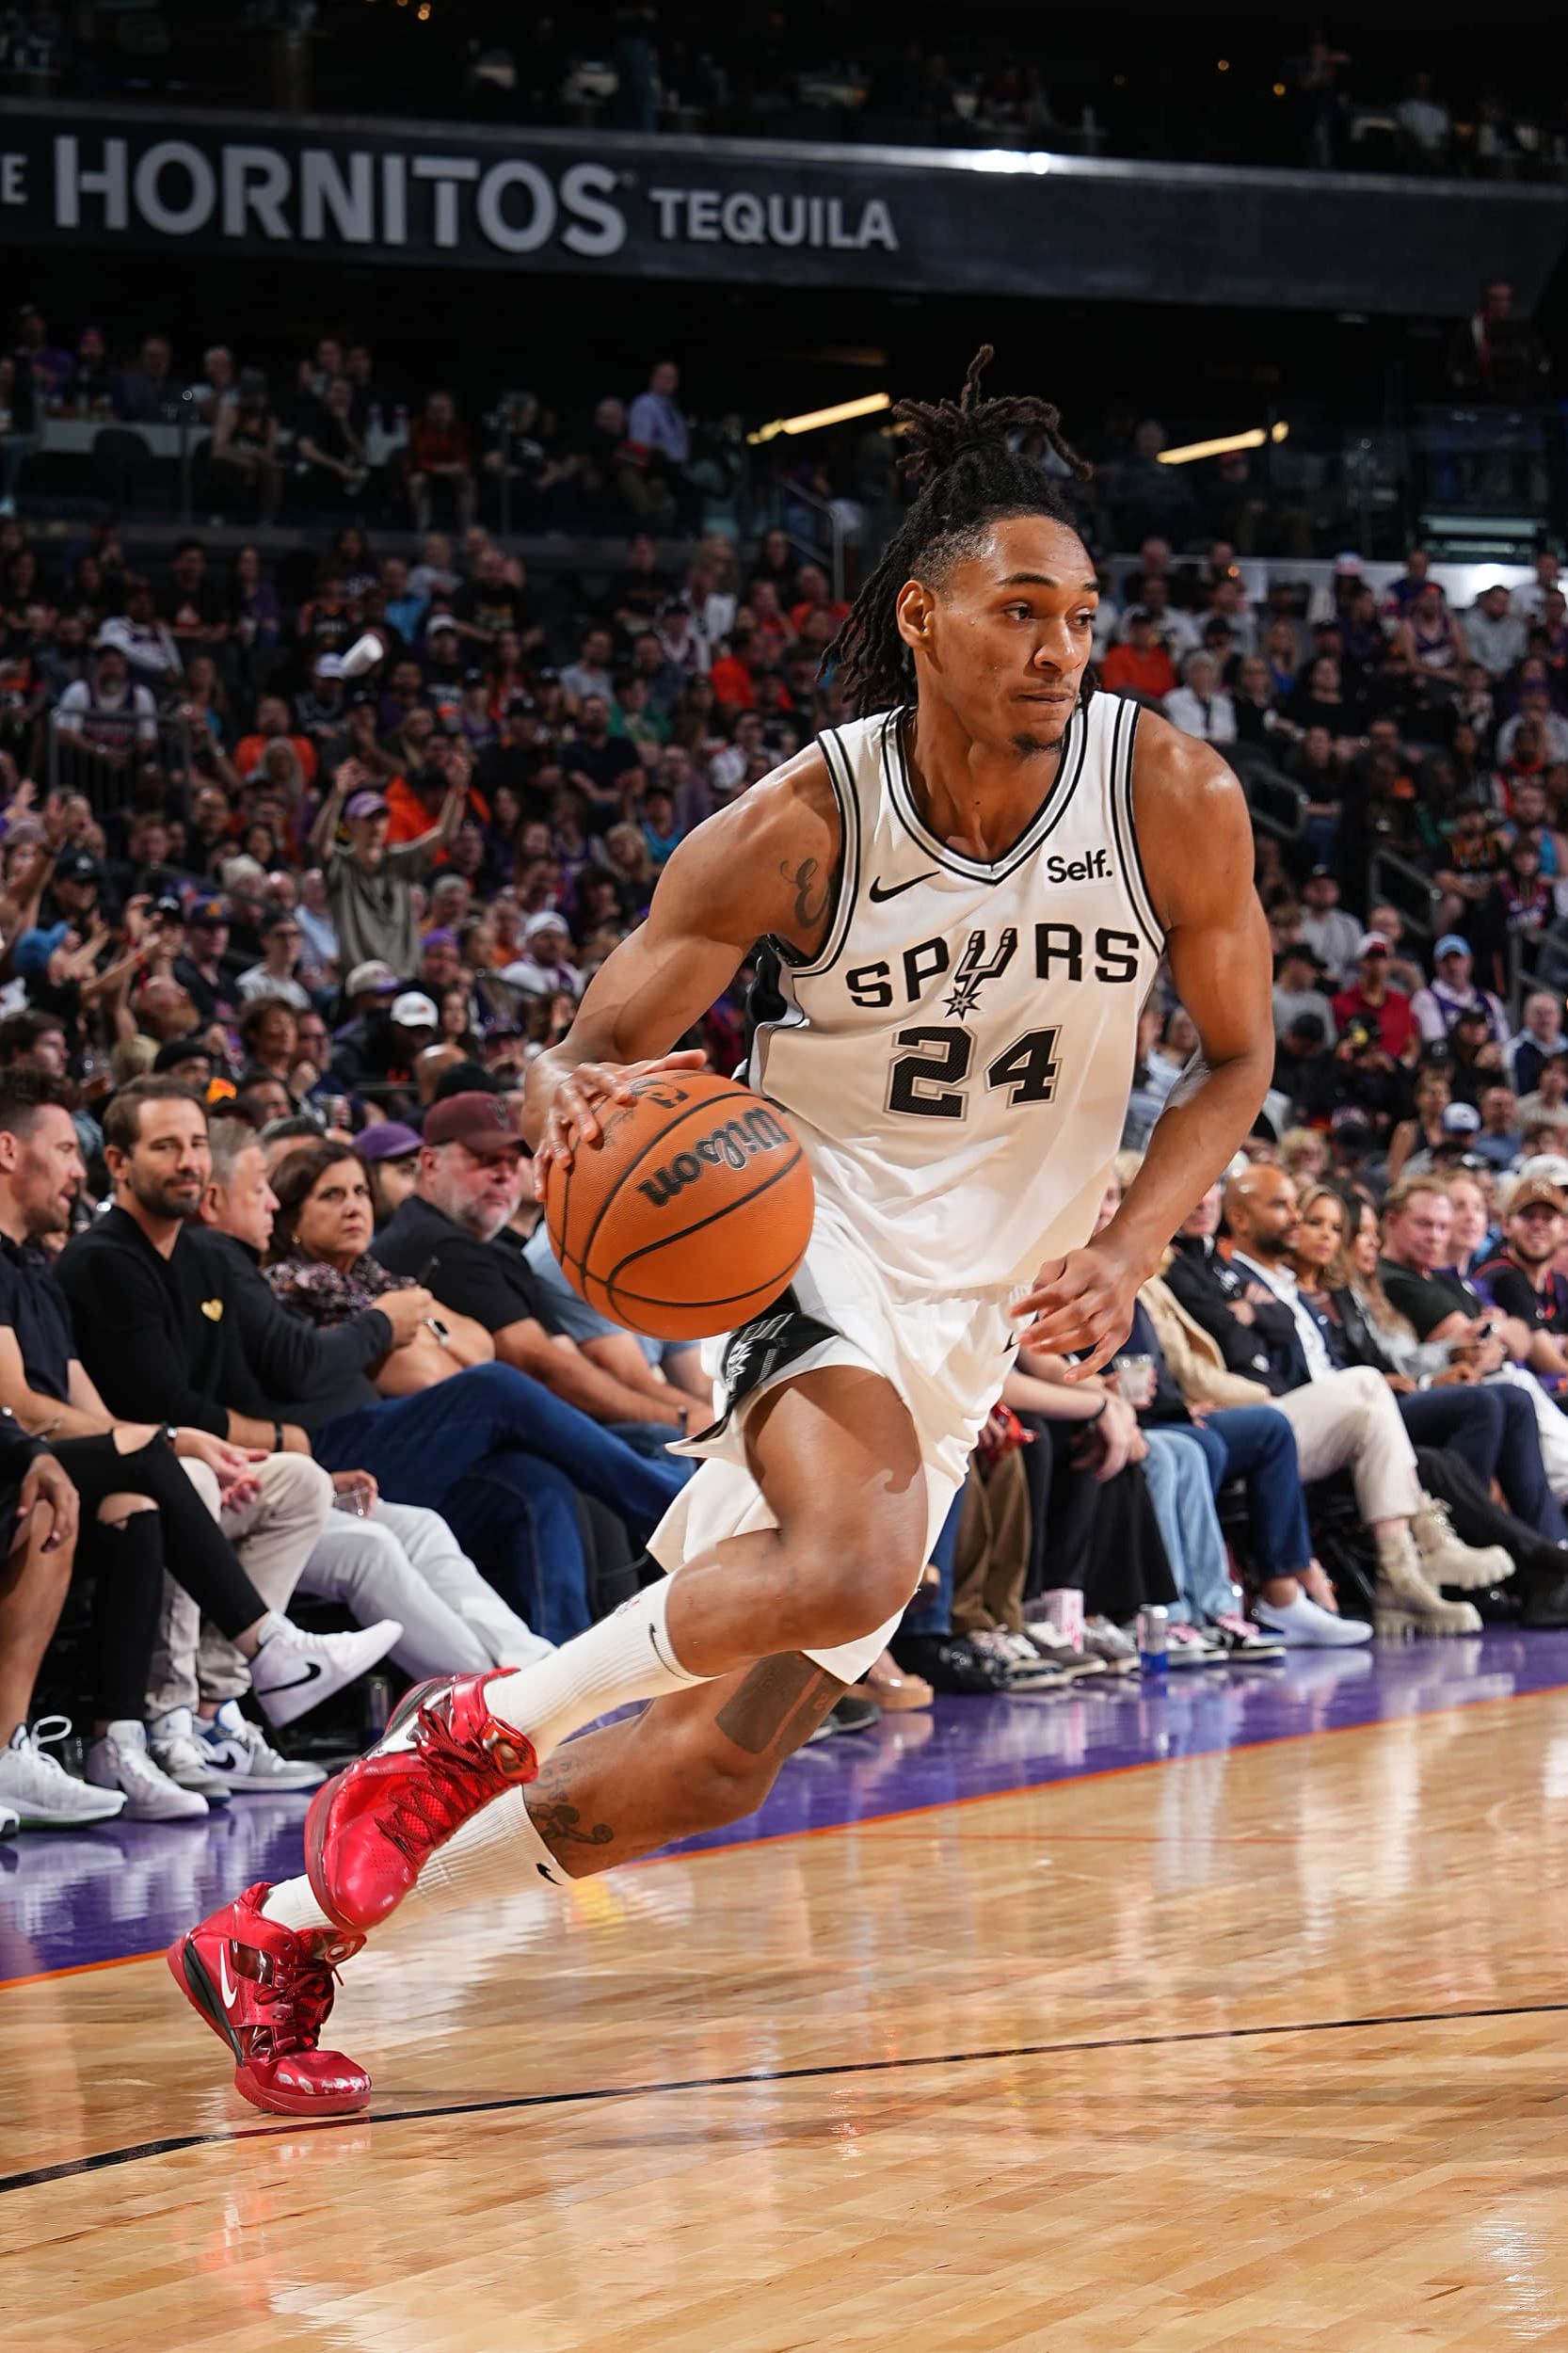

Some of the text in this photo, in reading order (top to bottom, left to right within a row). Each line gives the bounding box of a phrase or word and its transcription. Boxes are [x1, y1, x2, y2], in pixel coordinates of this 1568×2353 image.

[55, 136, 627, 256] HORNITOS
[649, 187, 899, 251] TEQUILA
[1048, 849, 1113, 883] Self.
[846, 923, 1140, 1021] SPURS
[883, 1025, 1063, 1121] 24
[636, 1107, 789, 1208] Wilson
